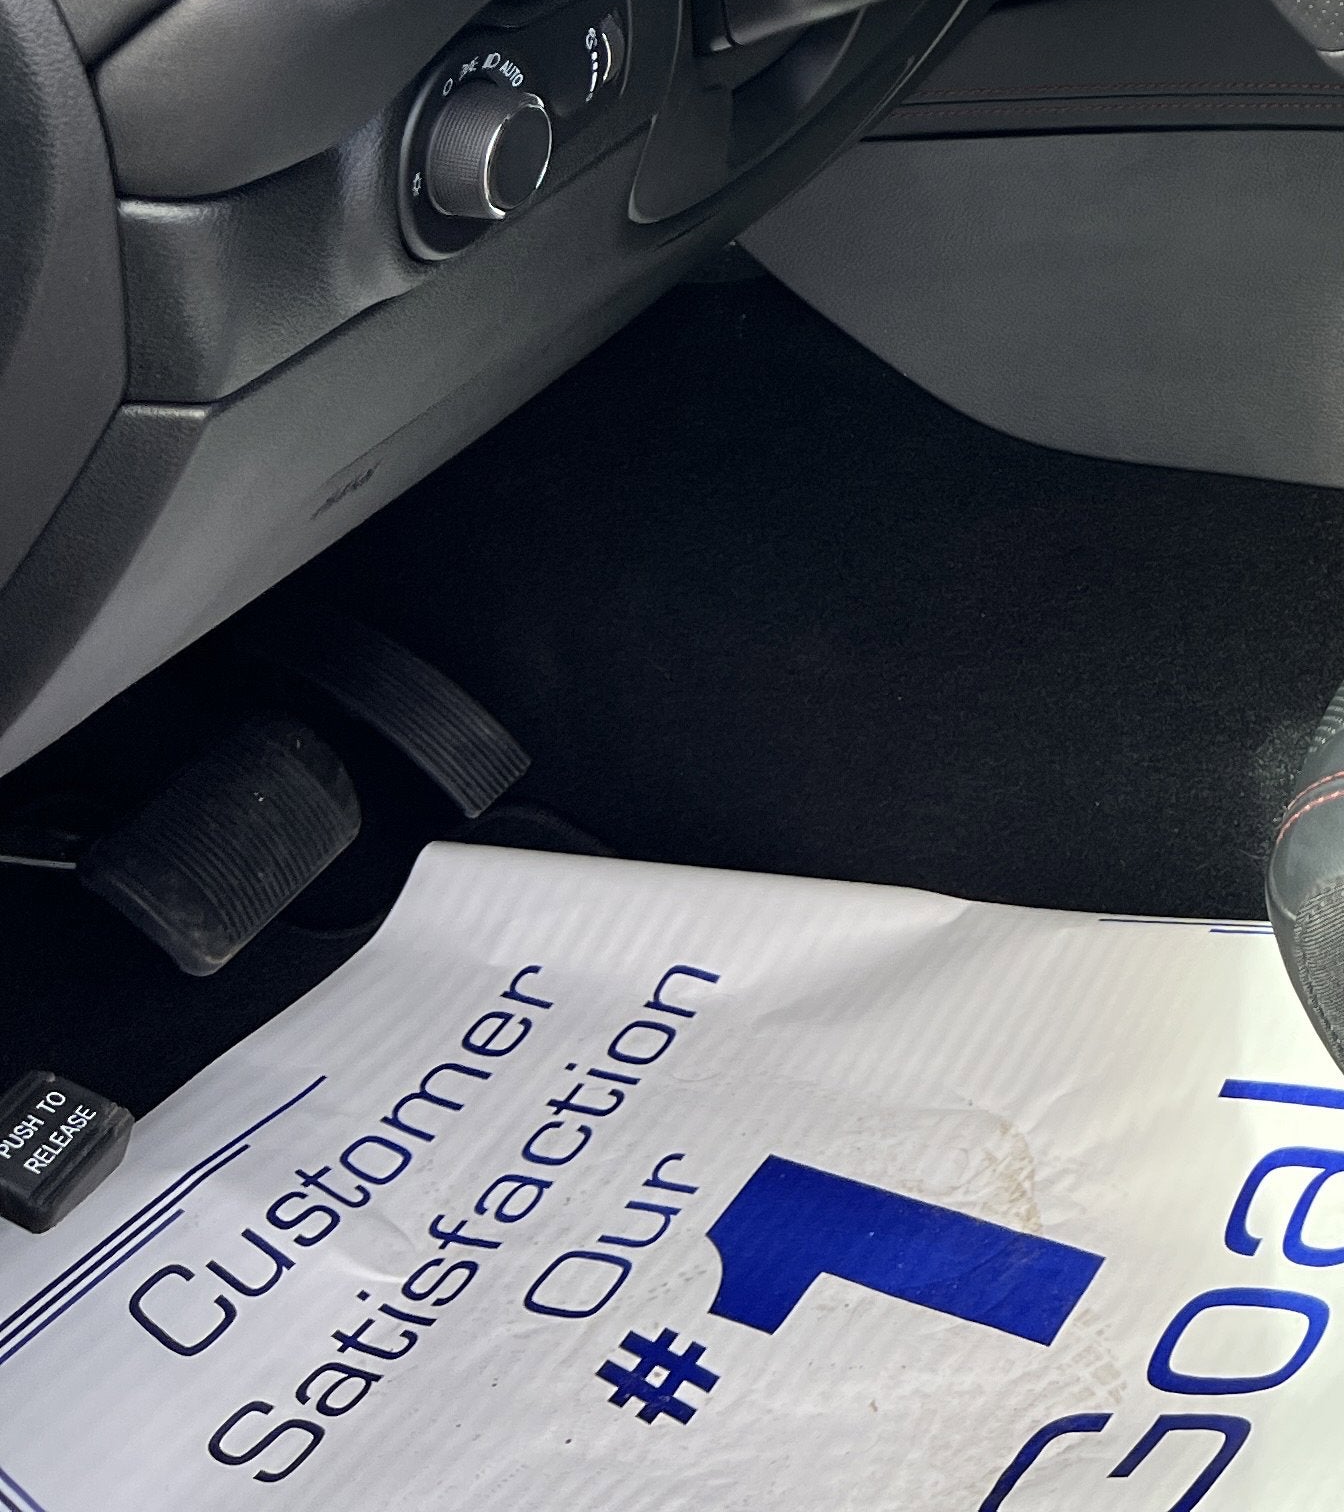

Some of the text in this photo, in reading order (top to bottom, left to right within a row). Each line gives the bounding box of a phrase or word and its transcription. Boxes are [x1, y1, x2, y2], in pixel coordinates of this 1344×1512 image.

[499, 60, 524, 87] AUTO
[0, 1091, 67, 1159] PUSH TO
[23, 1104, 97, 1175] RELEASE
[128, 964, 555, 1357] Customer
[207, 963, 721, 1483] Satisfaction
[523, 1152, 702, 1319] Our
